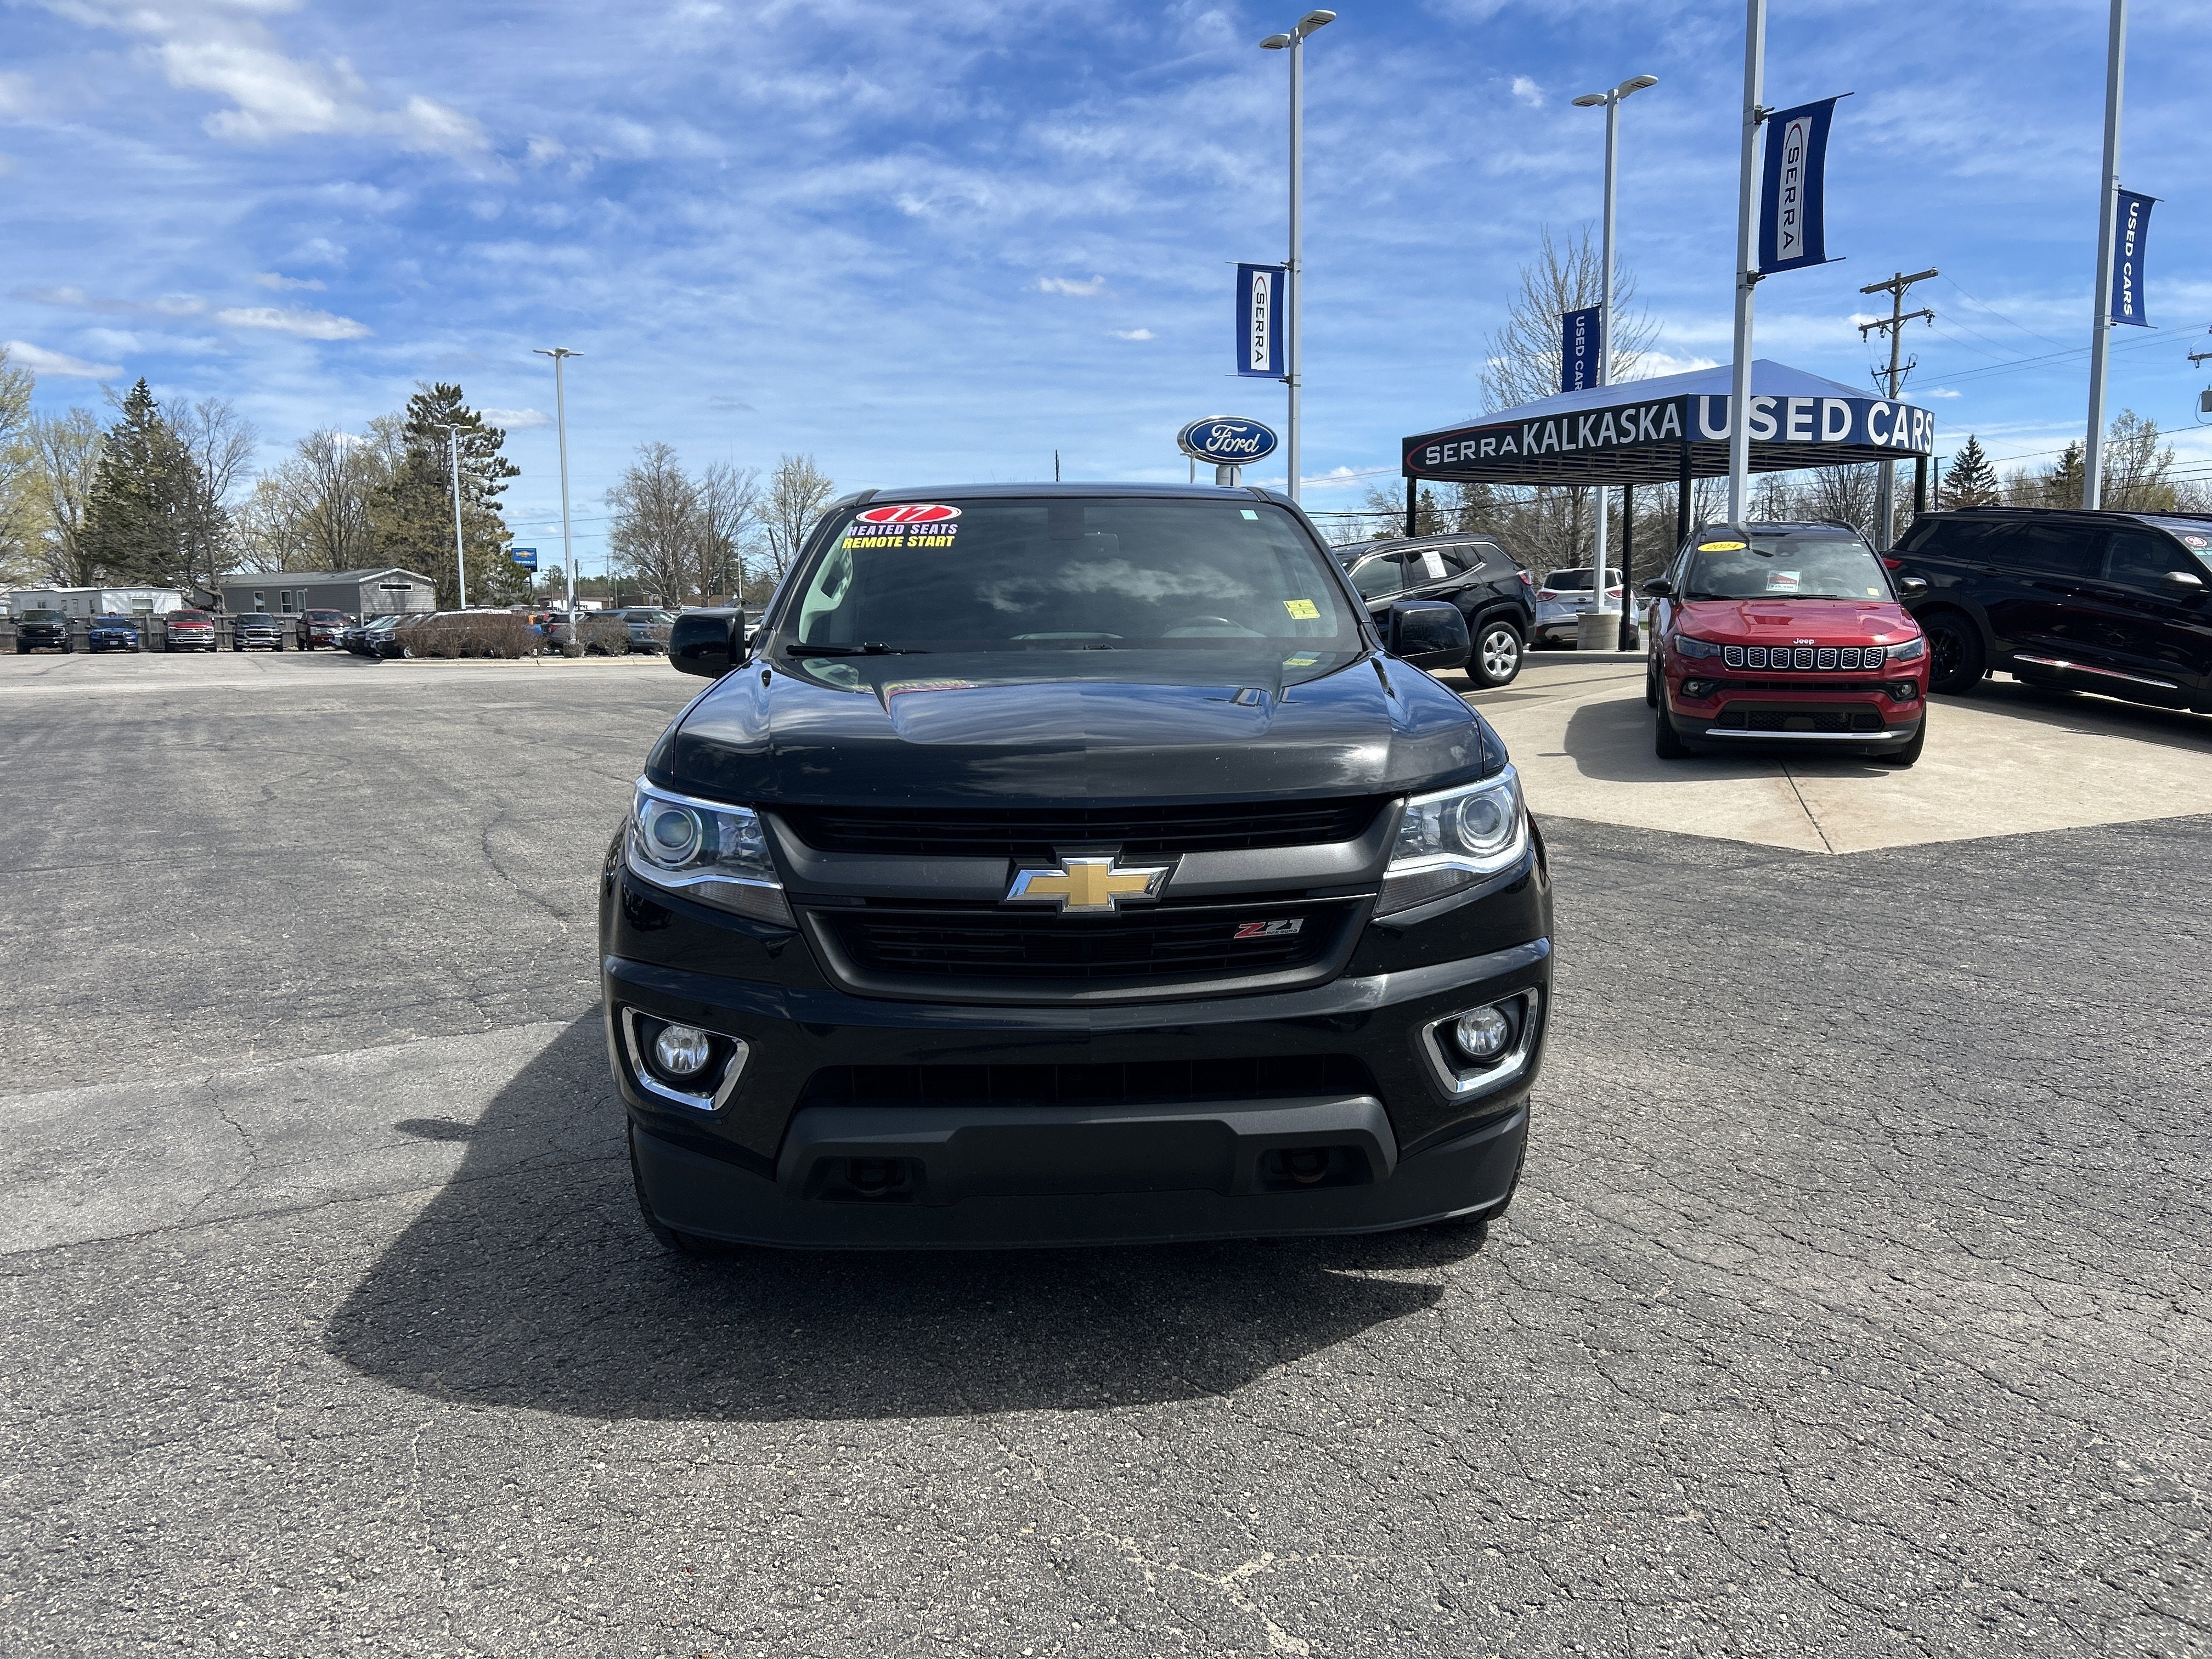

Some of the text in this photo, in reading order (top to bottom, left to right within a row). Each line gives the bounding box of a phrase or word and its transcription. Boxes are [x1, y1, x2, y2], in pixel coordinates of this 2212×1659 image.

[1783, 146, 1799, 250] SERRA
[2123, 202, 2140, 316] USED CARS
[1255, 292, 1265, 363] SERRA
[1575, 315, 1585, 391] USED CAR
[1205, 424, 1261, 453] Ford
[1425, 403, 1682, 465] SERRA KALKASKA
[1699, 396, 1933, 454] USED CARS
[842, 535, 955, 549] REMOTE START
[847, 523, 958, 536] HEATED SEATS
[881, 506, 936, 522] 17
